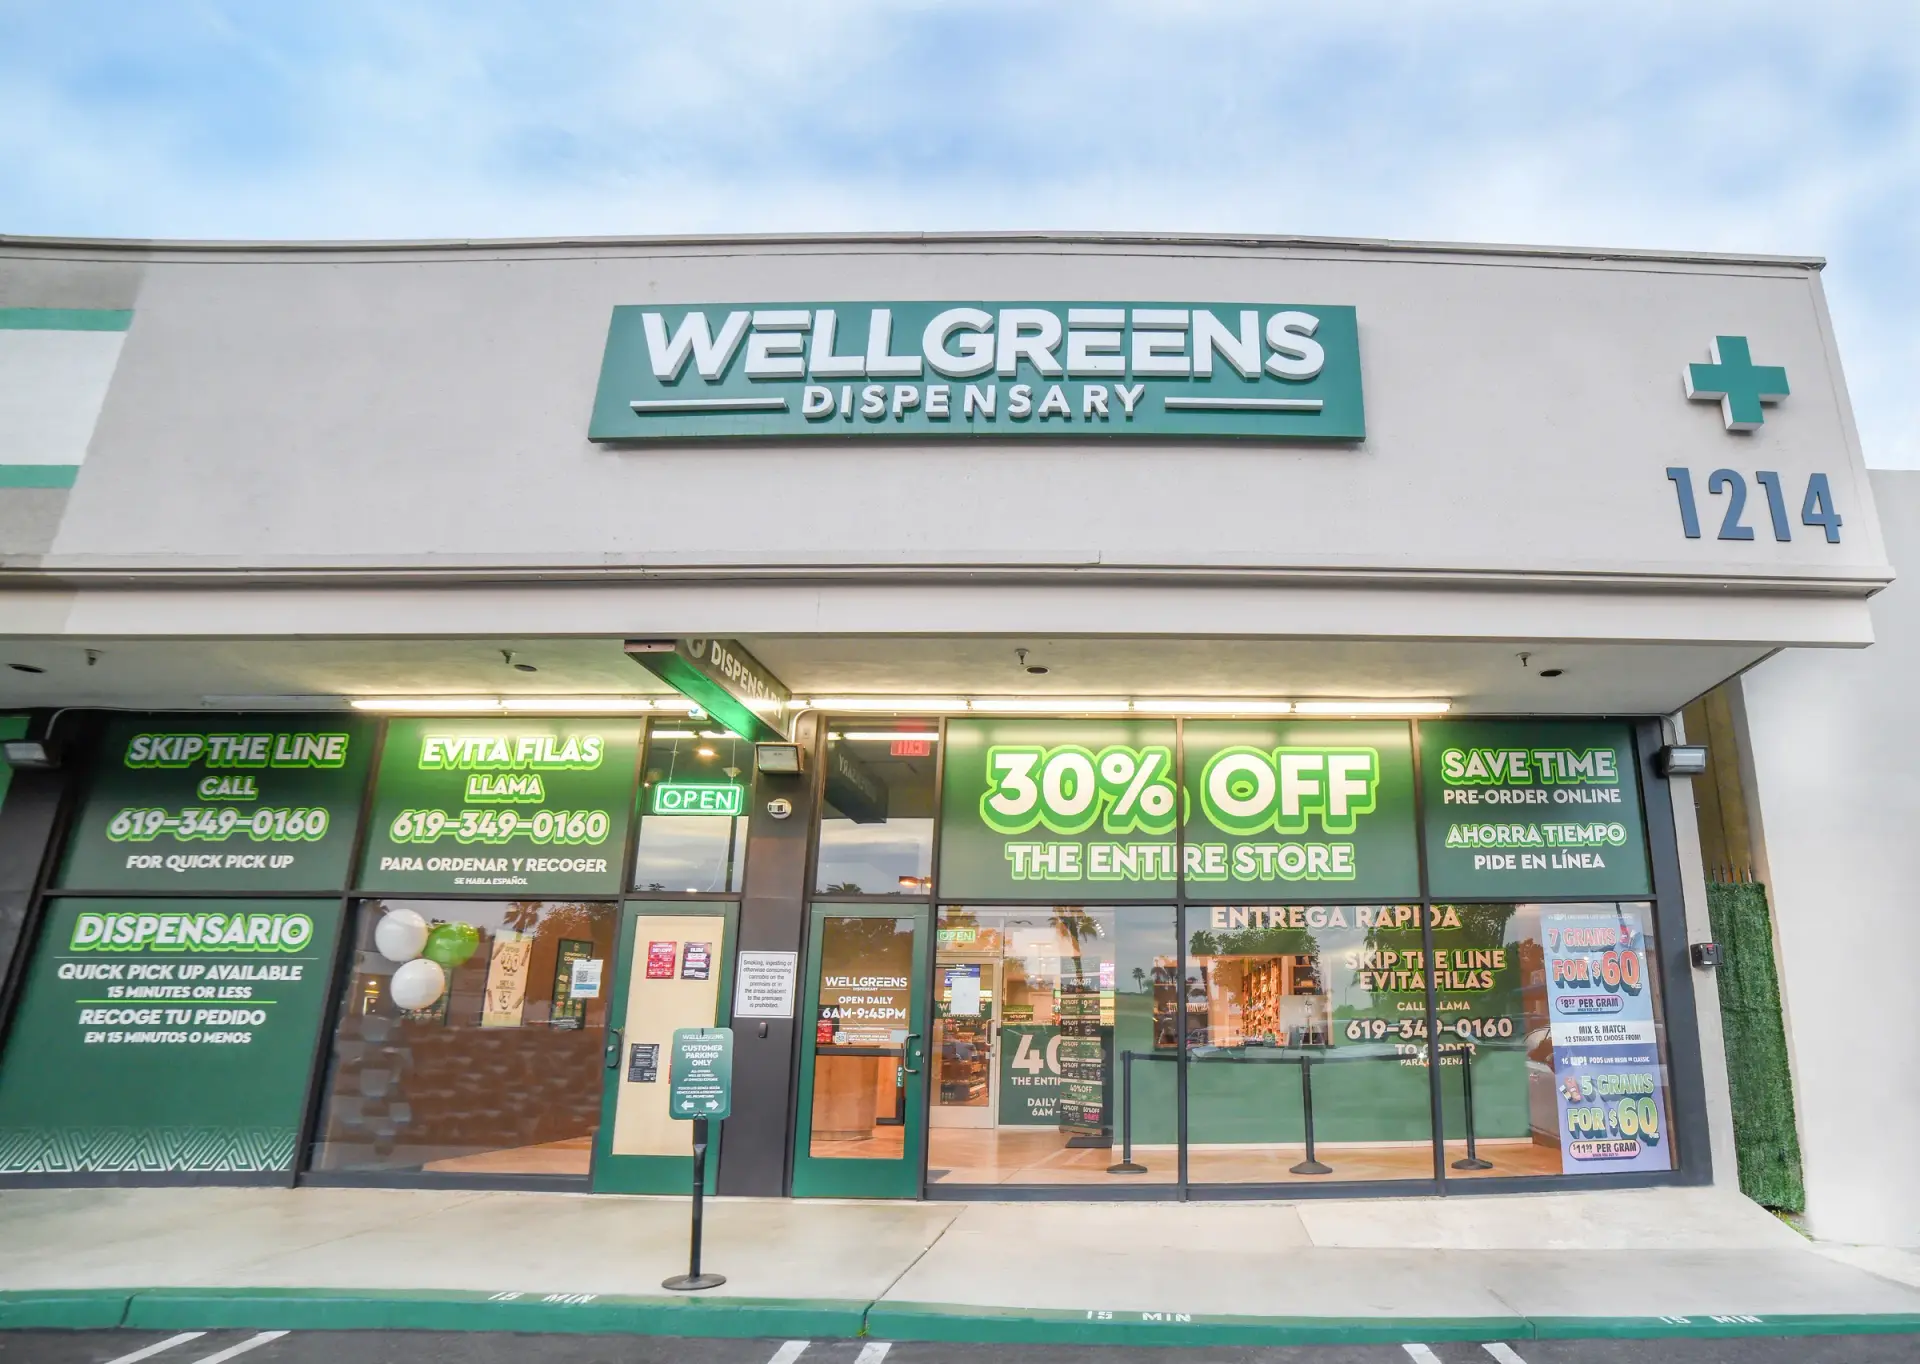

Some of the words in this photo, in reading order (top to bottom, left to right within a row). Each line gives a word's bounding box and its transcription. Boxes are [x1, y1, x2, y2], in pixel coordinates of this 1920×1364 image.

[641, 307, 1326, 383] WELLGREENS
[802, 383, 1147, 424] DISPENSARY
[1666, 467, 1843, 544] 1214
[127, 735, 205, 763] SKIP
[206, 735, 271, 763] THE
[274, 735, 346, 763] LINE
[422, 736, 510, 765] EVITA
[514, 736, 602, 765] FILAS
[1443, 750, 1530, 781] SAVE
[1533, 750, 1616, 781] TIME
[199, 777, 257, 797] CALL
[467, 775, 542, 798] LLAMA
[984, 750, 1177, 824] 30%
[1206, 750, 1374, 824] OFF
[662, 790, 733, 809] OPEN
[1444, 789, 1549, 804] PRE-ORDER
[1553, 789, 1621, 803] ONLINE
[108, 809, 329, 838] 619-349-0160
[391, 811, 607, 840] 619-349-0160
[1446, 825, 1543, 846] AHORRA
[1543, 824, 1626, 845] TIEMPO
[126, 855, 163, 869] FOR
[166, 855, 223, 872] QUICK
[225, 855, 268, 869] PICK
[269, 855, 294, 869] UP
[380, 857, 423, 871] PARA
[427, 858, 508, 872] ORDENAR
[511, 858, 524, 872] Y
[525, 858, 607, 873] RECOGER
[1006, 844, 1081, 876] THE
[1088, 844, 1228, 876] ENTIRE
[1233, 844, 1354, 876] STORE
[1474, 854, 1516, 870] PIDE
[1521, 854, 1547, 869] EN
[1552, 849, 1605, 869] LÍNEA
[454, 877, 465, 885] SE
[465, 877, 492, 885] HABLA
[492, 876, 528, 885] ESPAÑOL
[1211, 906, 1348, 928] ENTREGA
[73, 915, 311, 947] DISPENSARIO
[939, 931, 972, 941] OPEN
[1549, 928, 1560, 947] 7
[1563, 927, 1616, 948] GRAMS
[1344, 950, 1398, 970] SKIP
[1455, 950, 1506, 969] LINE
[1552, 959, 1589, 983] FOR
[1592, 950, 1641, 987] $60
[57, 964, 126, 980] QUICK
[127, 964, 175, 980] PICK
[177, 965, 204, 980] UP
[204, 965, 304, 981] AVAILABLE
[1358, 971, 1425, 989] EVITA
[1433, 970, 1494, 989] FILAS
[825, 976, 908, 987] WELLGREENS
[107, 986, 124, 998] 15
[126, 986, 191, 998] MINUTES
[193, 986, 215, 998] OR
[218, 986, 252, 998] LESS
[838, 996, 864, 1005] OPEN
[867, 996, 893, 1005] DAILY
[1397, 1002, 1425, 1011] CALL
[1436, 1002, 1471, 1011] LAMA
[1579, 998, 1594, 1008] PER
[1596, 998, 1619, 1008] GRAM
[79, 1009, 160, 1025] RECOGE
[165, 1009, 192, 1025] TU
[194, 1009, 266, 1025] PEDIDO
[822, 1007, 906, 1020] 6AM-9:45PM
[84, 1032, 105, 1043] EN
[107, 1032, 123, 1043] 15
[124, 1032, 188, 1043] MINUTOS
[190, 1032, 201, 1043] O
[202, 1032, 252, 1043] MENOS
[1578, 1025, 1592, 1035] MIX
[1594, 1026, 1600, 1034] &
[1602, 1024, 1627, 1034] MATCH
[1573, 1035, 1595, 1043] STRAINS
[1603, 1034, 1624, 1042] CHOOSE
[682, 1044, 723, 1052] CUSTOMER
[1395, 1043, 1418, 1056] TO
[1400, 1058, 1424, 1067] PARA
[1012, 1077, 1032, 1086] THE
[1581, 1075, 1593, 1097] 5
[1597, 1073, 1655, 1097] GRAMS
[1028, 1098, 1057, 1107] DAILY
[1032, 1108, 1053, 1117] 6AM
[1566, 1107, 1606, 1133] FOR
[1609, 1097, 1659, 1136] $60
[1596, 1144, 1612, 1153] PER
[1615, 1143, 1637, 1153] GRAM
[541, 1294, 599, 1304] MIN
[1087, 1310, 1113, 1320] 15
[1142, 1312, 1191, 1323] MIN
[1710, 1316, 1763, 1324] MIN
